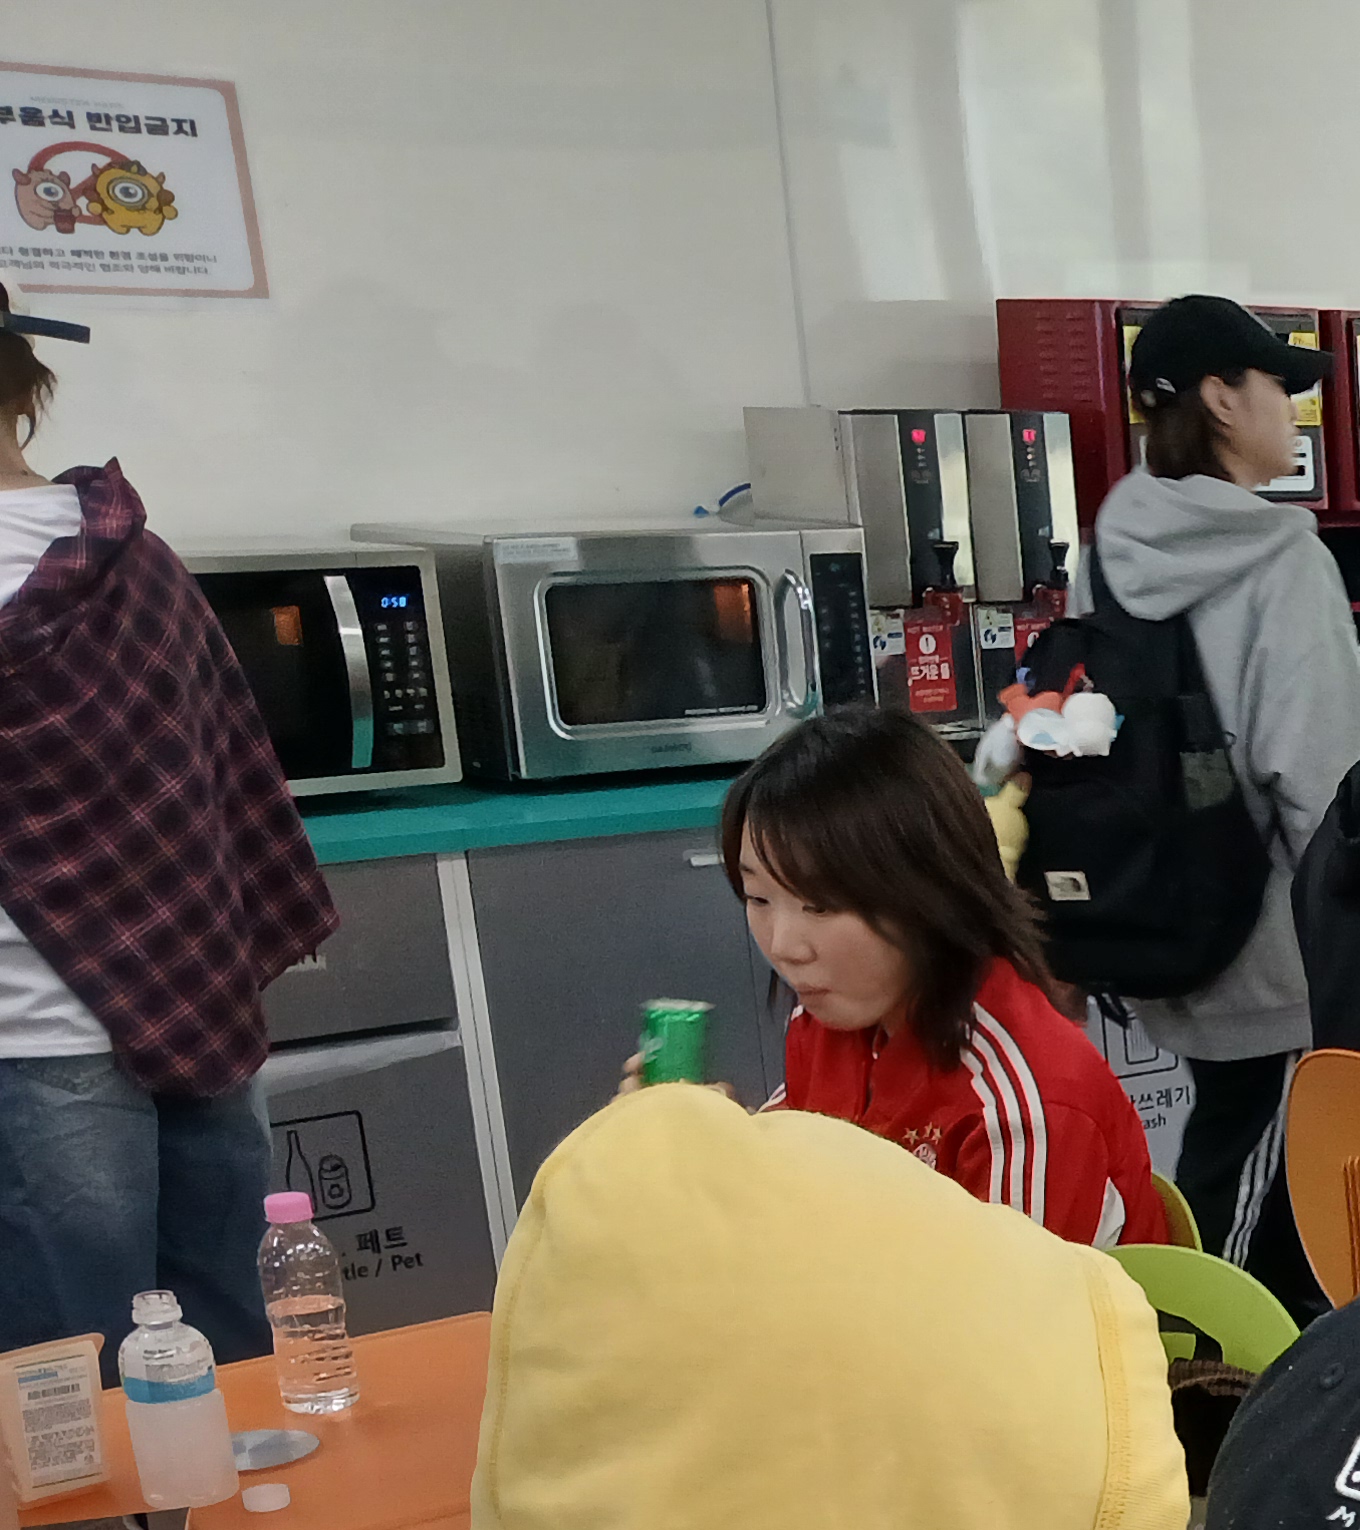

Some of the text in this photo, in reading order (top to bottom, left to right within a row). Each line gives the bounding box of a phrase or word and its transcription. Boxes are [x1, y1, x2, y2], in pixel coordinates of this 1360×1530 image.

[86, 111, 198, 137] 반입금지
[356, 1226, 408, 1253] 페트
[391, 1252, 423, 1271] Pet
